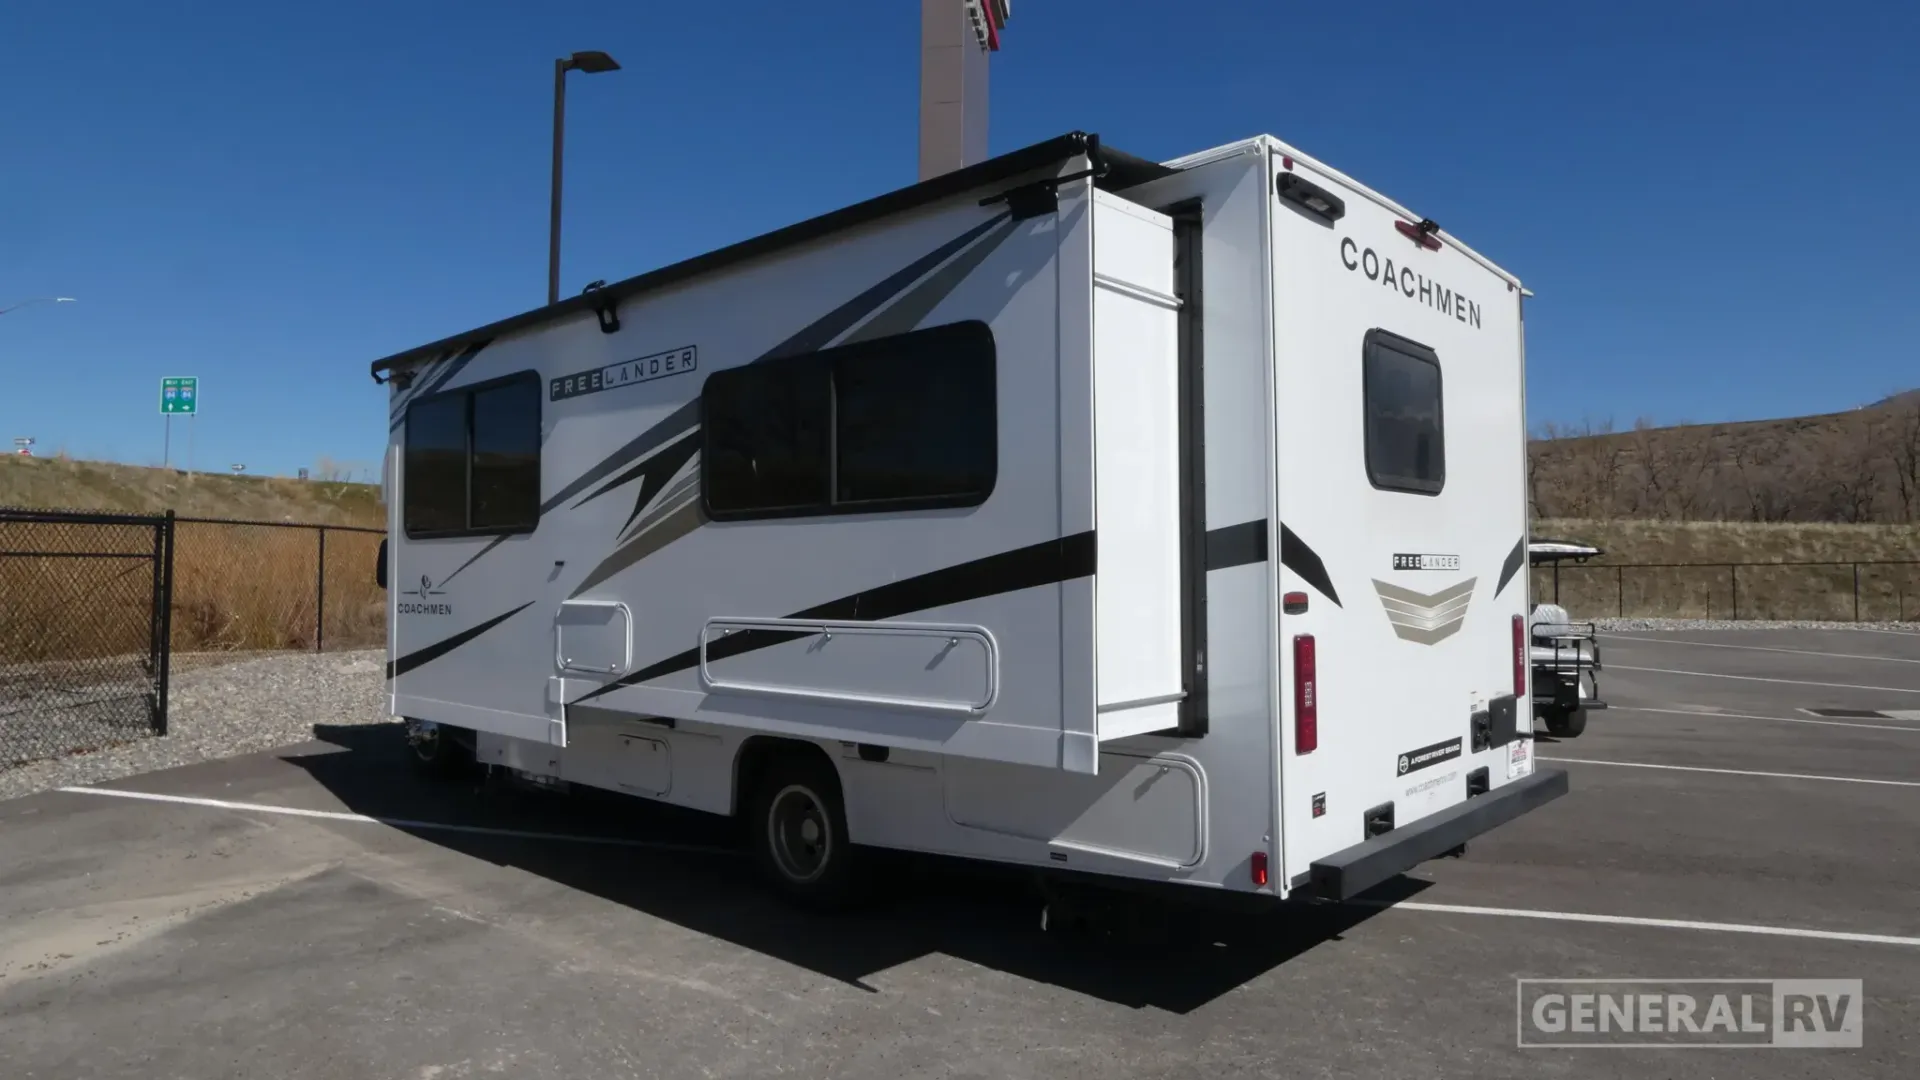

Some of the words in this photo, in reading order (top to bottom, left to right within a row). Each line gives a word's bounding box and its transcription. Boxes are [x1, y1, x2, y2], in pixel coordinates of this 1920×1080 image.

[1340, 236, 1481, 330] COACHMEN
[551, 350, 692, 397] FREELANDER
[1394, 556, 1458, 567] FREELANDER
[398, 603, 452, 615] COACHMEN
[1445, 744, 1460, 754] BRAND
